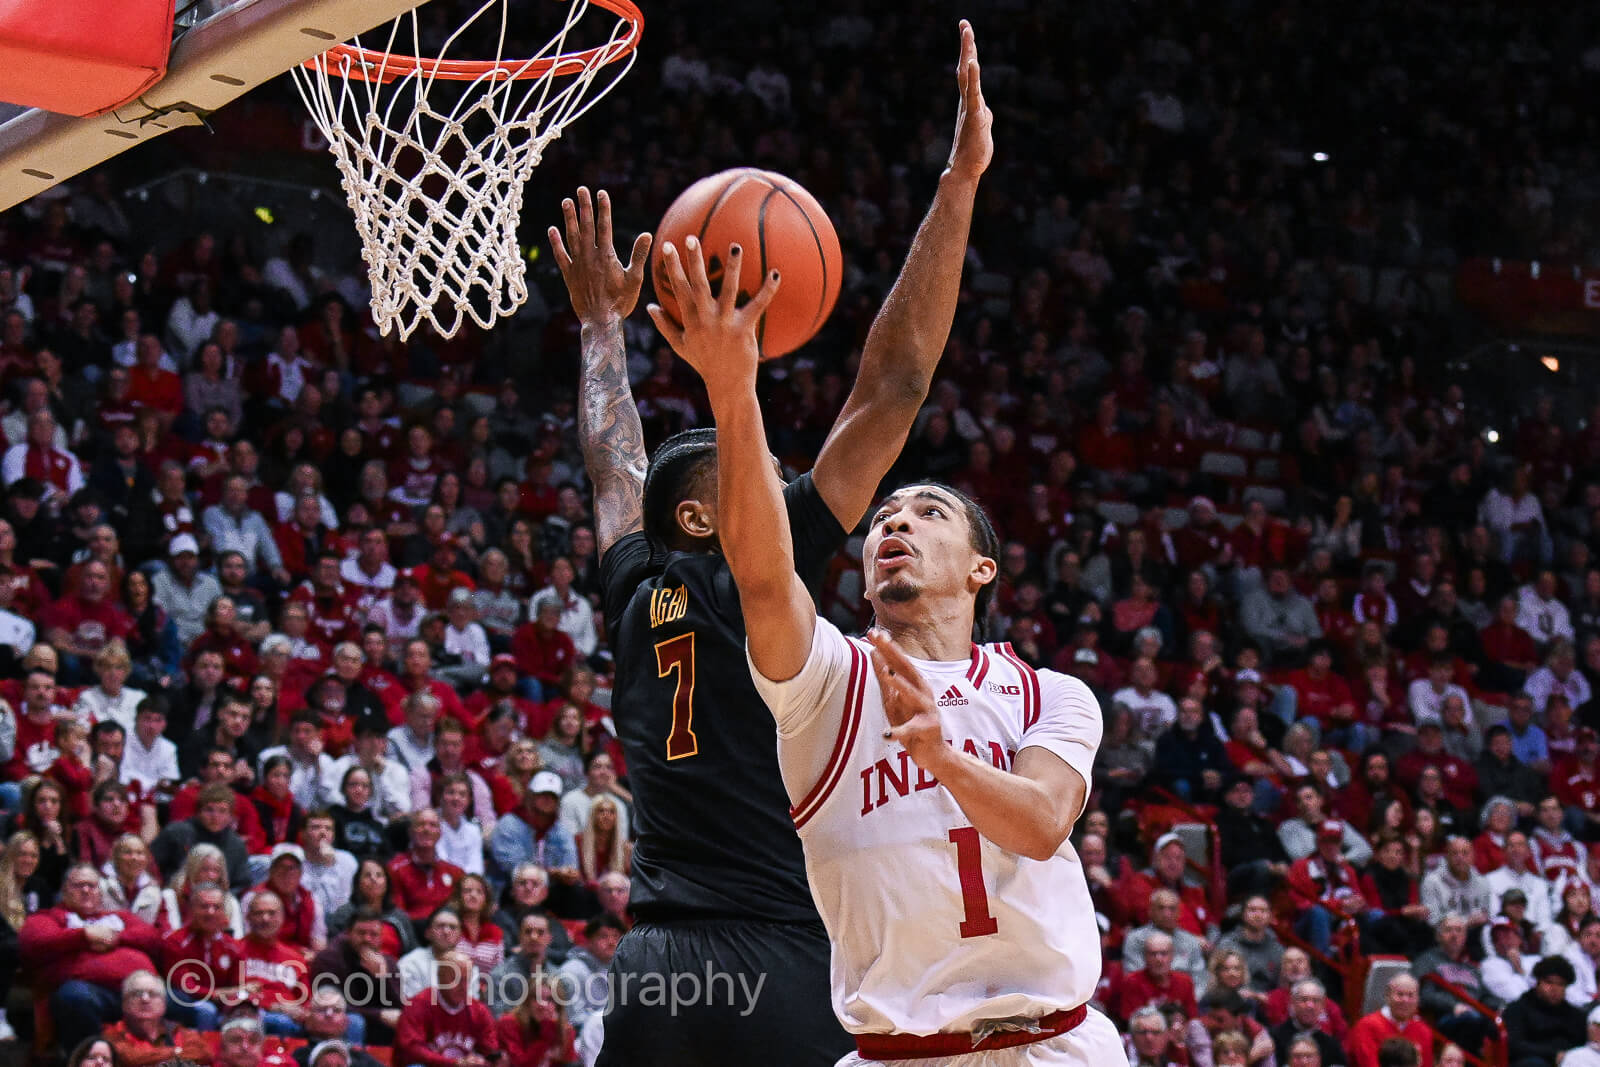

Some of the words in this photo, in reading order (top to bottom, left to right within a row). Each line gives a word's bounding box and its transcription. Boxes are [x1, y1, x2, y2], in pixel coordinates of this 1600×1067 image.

[654, 631, 698, 761] 7
[937, 697, 969, 707] adidas
[949, 827, 998, 939] 1
